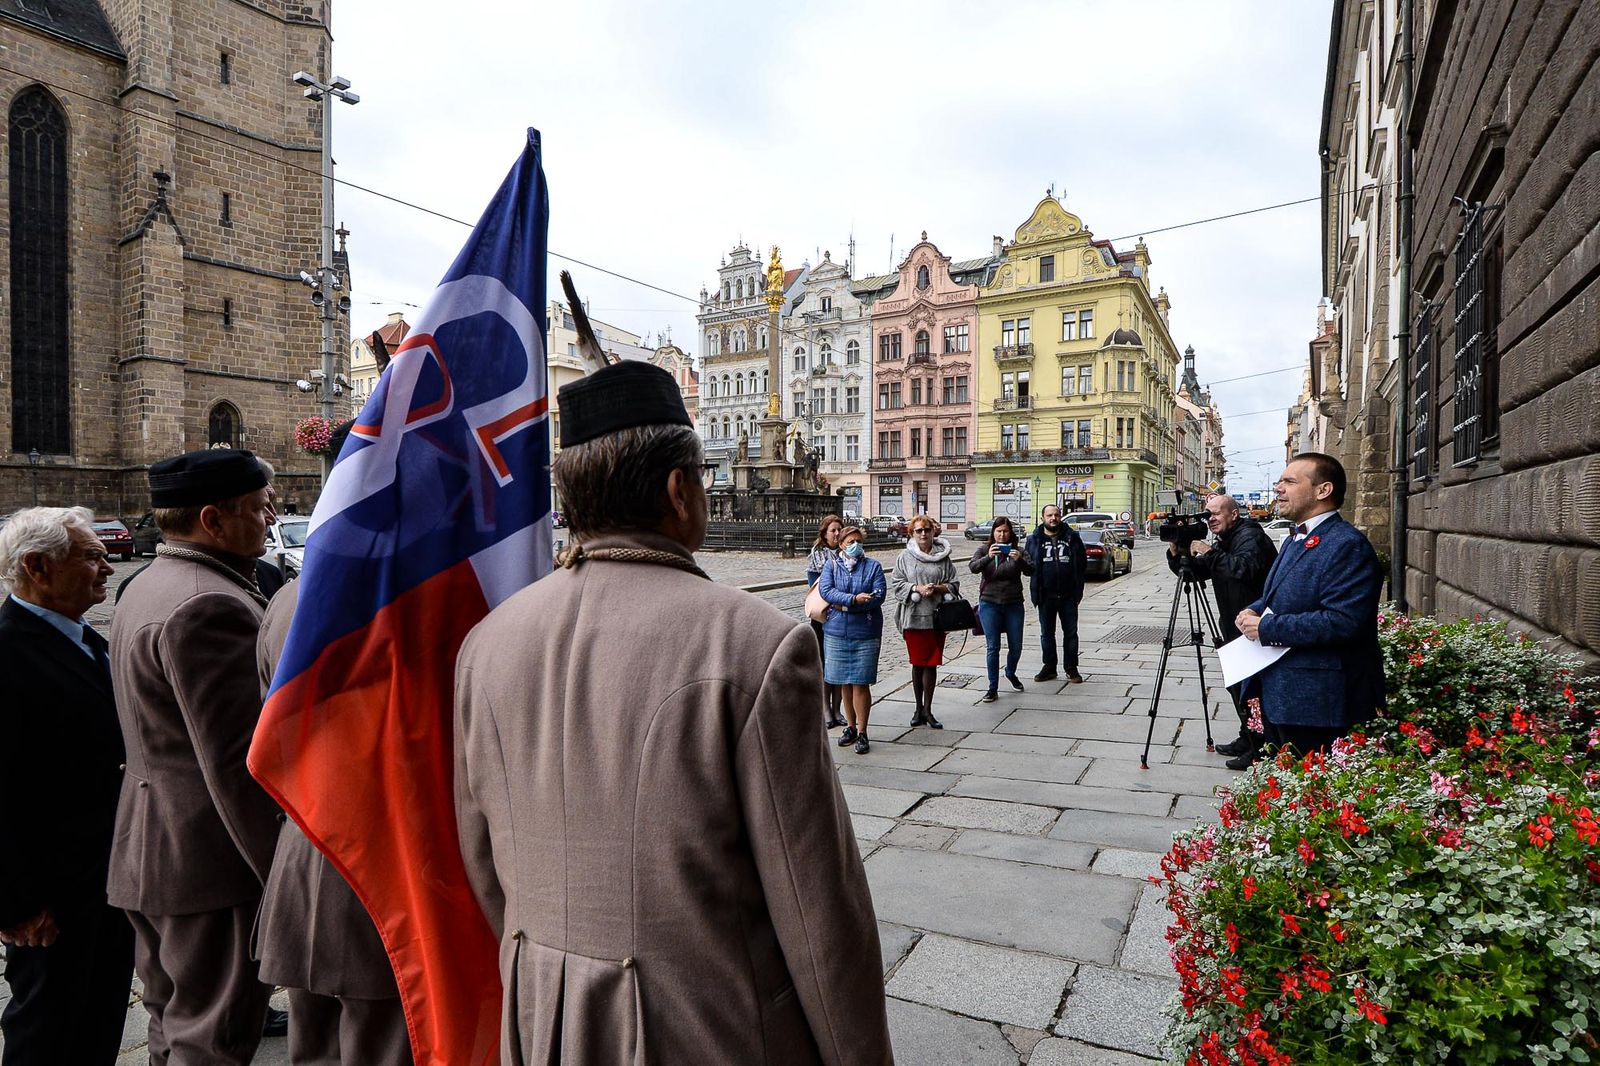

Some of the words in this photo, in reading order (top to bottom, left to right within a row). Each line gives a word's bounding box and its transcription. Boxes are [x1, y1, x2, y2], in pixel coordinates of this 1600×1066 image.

[1056, 466, 1092, 475] CASINO
[879, 476, 901, 484] HAPPY
[944, 474, 960, 482] DAY
[1044, 543, 1065, 557] 77
